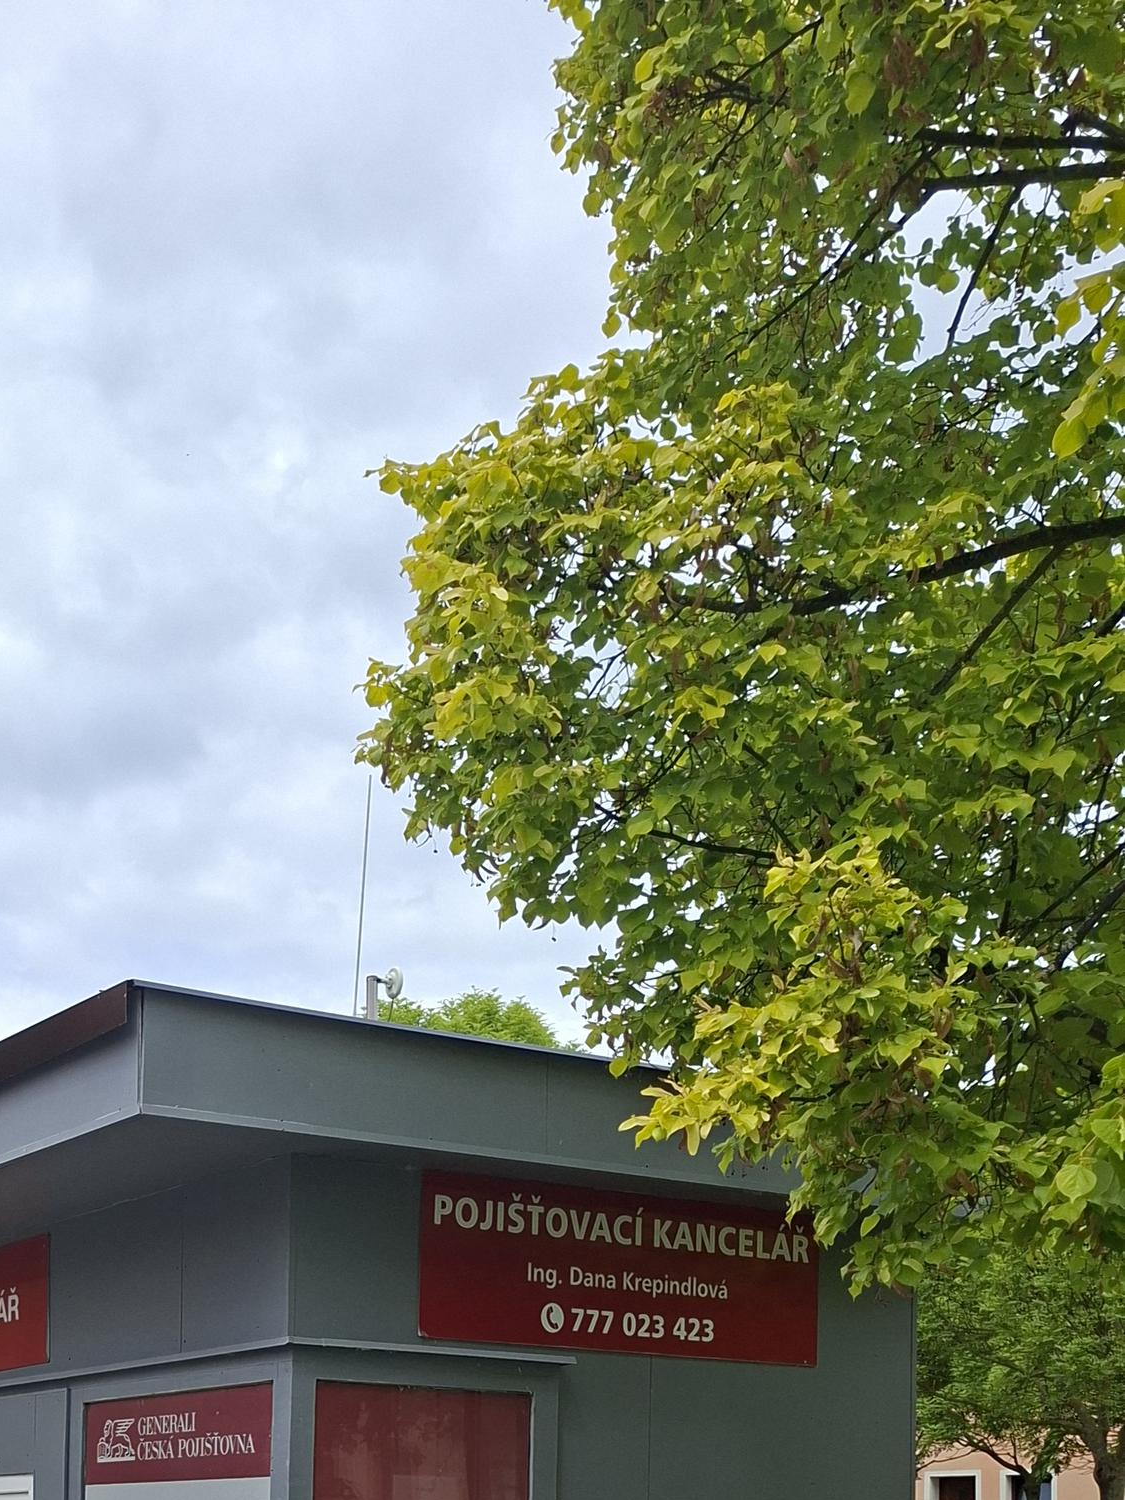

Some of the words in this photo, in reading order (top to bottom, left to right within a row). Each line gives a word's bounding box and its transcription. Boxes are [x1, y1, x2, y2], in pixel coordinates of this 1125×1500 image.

[433, 1193, 644, 1247] POJIŠŤOVACÍ
[653, 1219, 810, 1264] KANCELÁŘ
[527, 1262, 562, 1290] Ing.
[570, 1267, 616, 1289] Dana
[623, 1271, 729, 1300] Krepindlová
[571, 1308, 614, 1335] 777
[623, 1312, 665, 1338] 023
[673, 1318, 715, 1342] 423
[137, 1412, 196, 1436] GENERALI
[137, 1436, 174, 1461] ČESKÁ
[177, 1432, 255, 1458] POJIŠŤOVNA
